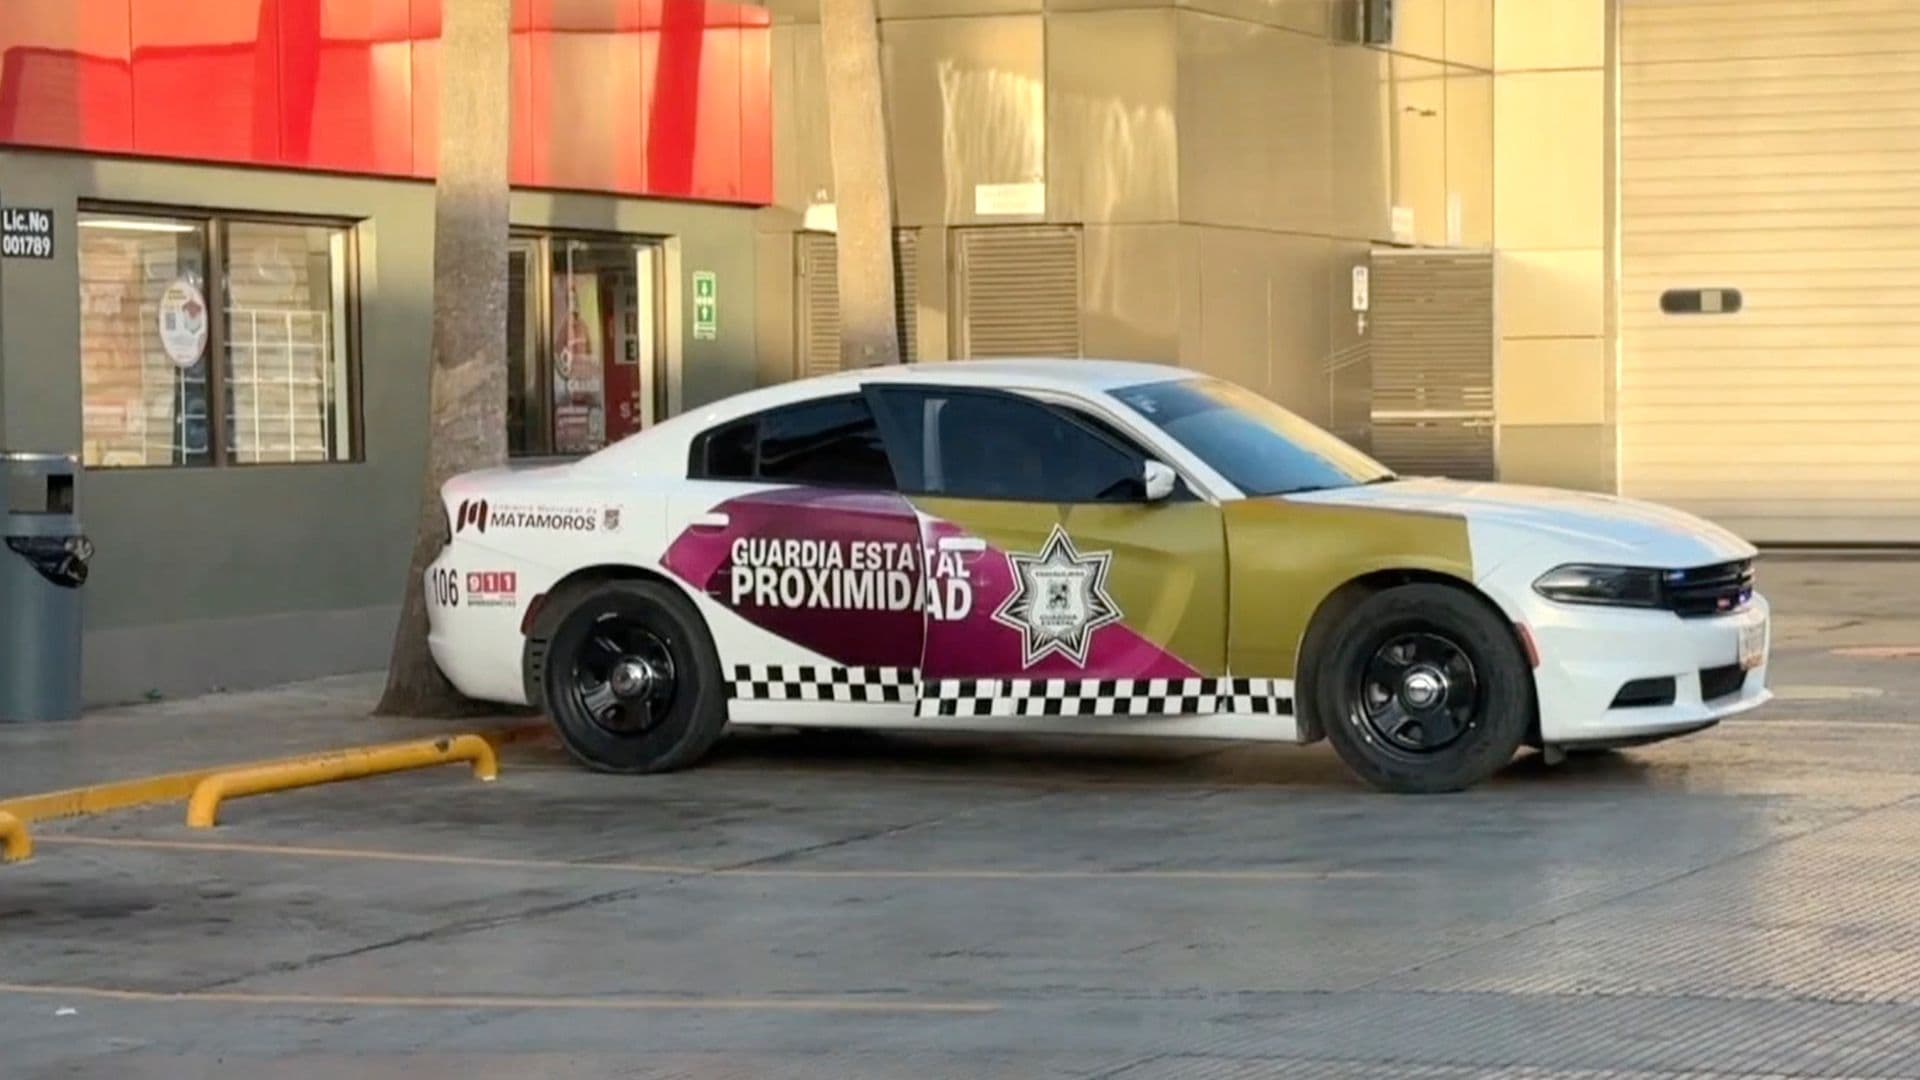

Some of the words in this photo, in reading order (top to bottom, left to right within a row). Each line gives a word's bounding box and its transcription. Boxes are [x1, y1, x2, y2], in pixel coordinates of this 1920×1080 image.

[3, 208, 49, 232] Lic.No
[3, 234, 51, 257] 001789
[490, 511, 596, 531] MATAMOROS
[731, 537, 844, 569] GUARDIA
[850, 541, 971, 579] ESTATAL
[433, 567, 459, 607] 106
[468, 573, 514, 592] 911
[731, 565, 972, 621] PROXIMIDAD
